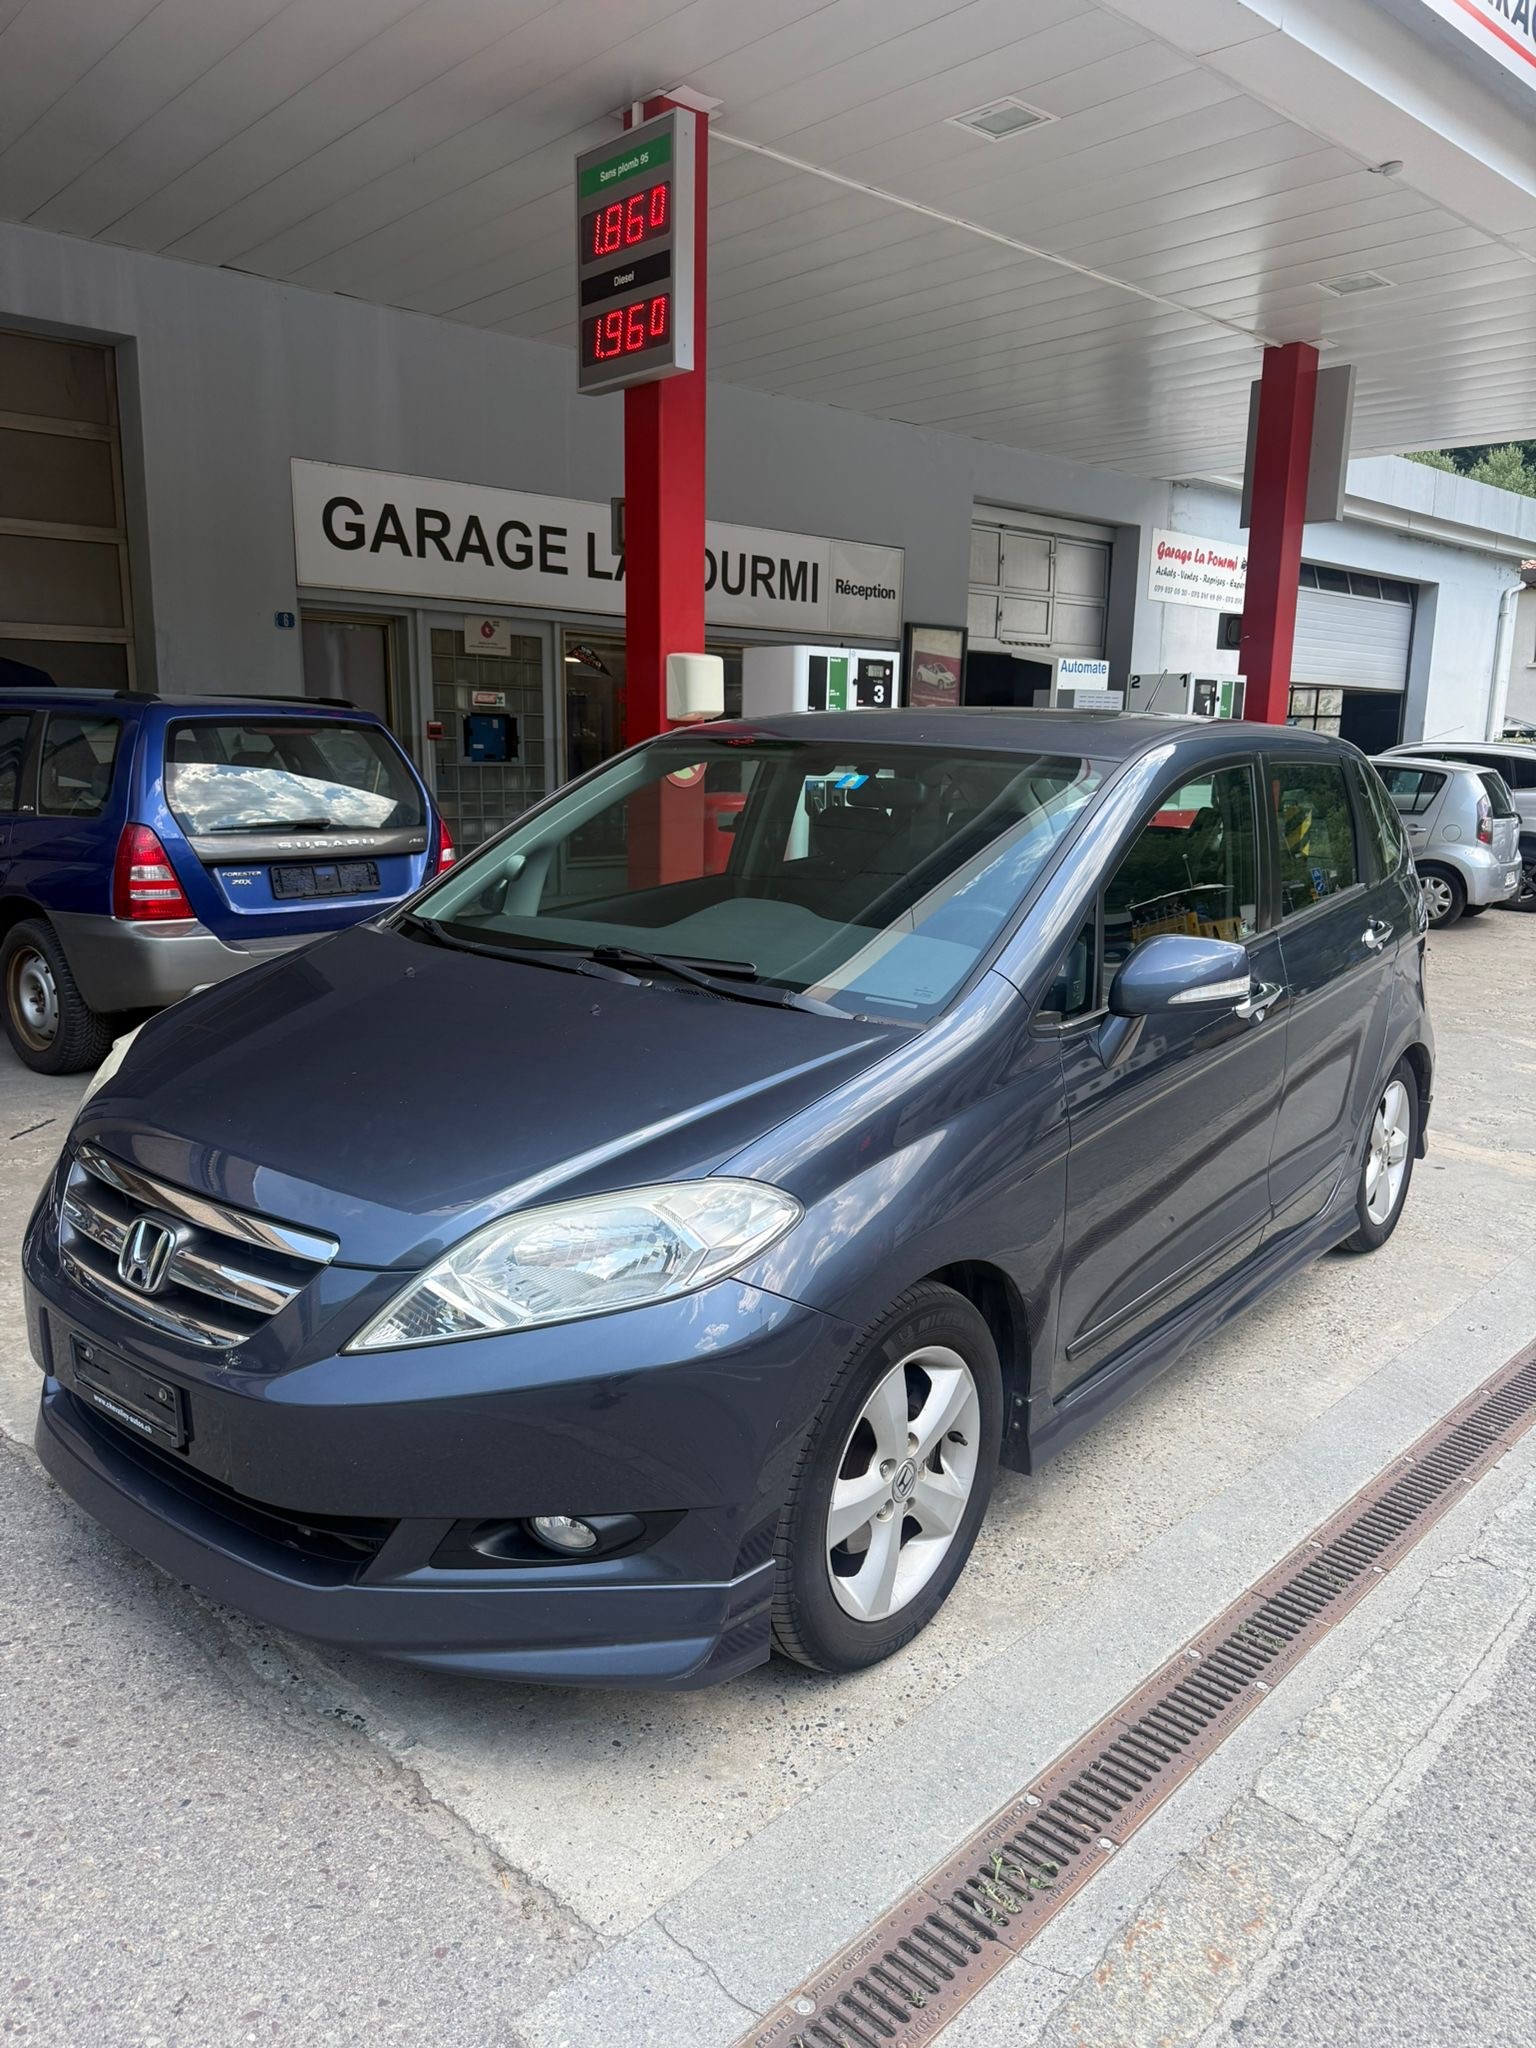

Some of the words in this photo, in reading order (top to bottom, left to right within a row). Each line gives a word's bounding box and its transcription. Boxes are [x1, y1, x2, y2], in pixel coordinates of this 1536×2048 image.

[600, 168, 617, 182] Sans
[617, 157, 639, 177] plomb
[640, 151, 649, 165] 95
[614, 270, 635, 287] Diesel
[322, 496, 569, 576] GARAGE
[587, 531, 625, 582] L
[705, 547, 819, 604] OURMI
[1157, 541, 1193, 565] Garage
[1194, 548, 1205, 565] La
[1207, 550, 1239, 572] Fourmi
[1155, 566, 1177, 579] Achats
[1180, 570, 1198, 582] Ventes
[1203, 574, 1226, 587] Reprises
[835, 578, 896, 600] Réception
[1060, 659, 1107, 675] Automate
[1131, 675, 1141, 689] 2
[1180, 673, 1188, 688] 1
[873, 685, 884, 703] 3
[1204, 700, 1211, 715] 1
[278, 838, 375, 850] SUBARU
